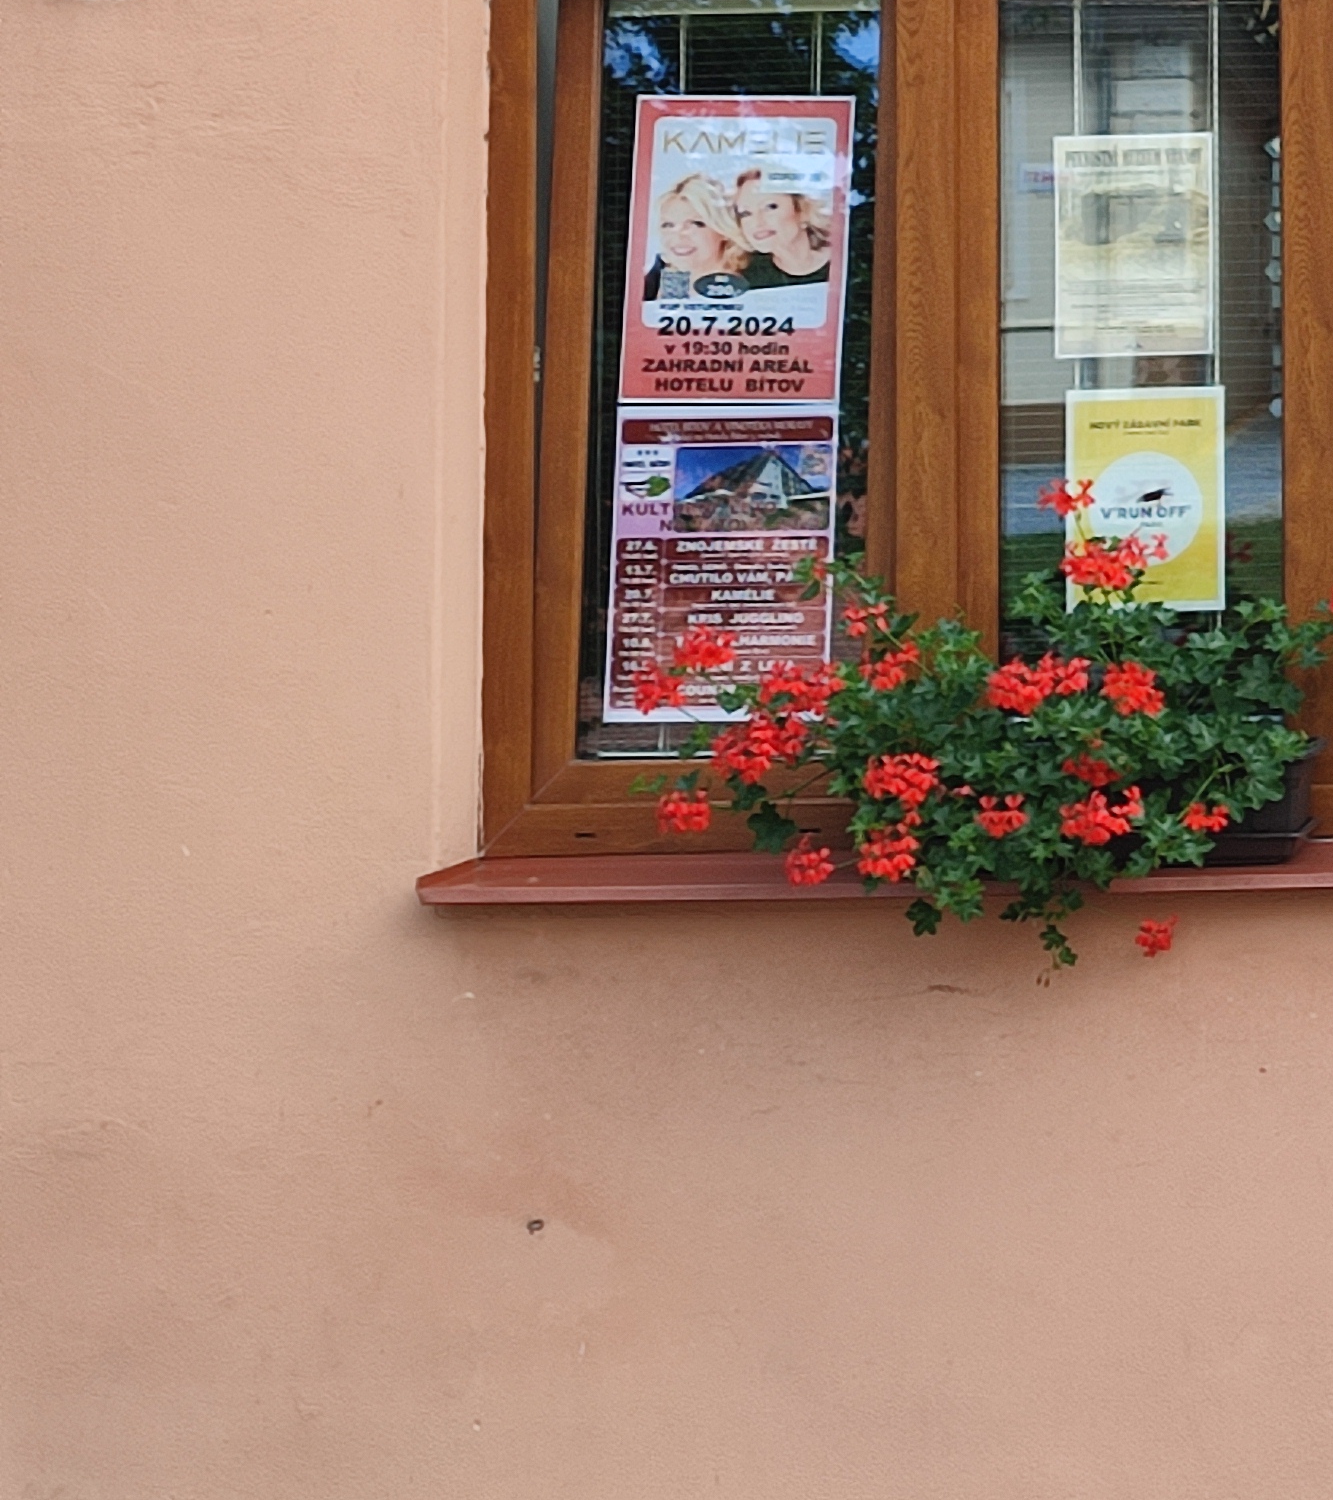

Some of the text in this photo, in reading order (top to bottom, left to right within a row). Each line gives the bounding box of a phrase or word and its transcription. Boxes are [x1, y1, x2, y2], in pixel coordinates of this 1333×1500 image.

[657, 316, 796, 337] 20.7.2024
[664, 341, 790, 356] v 19:30 hodin
[641, 356, 814, 373] ZAHRADNÍ AREÁL
[655, 375, 805, 393] HOTELU BÍTOV
